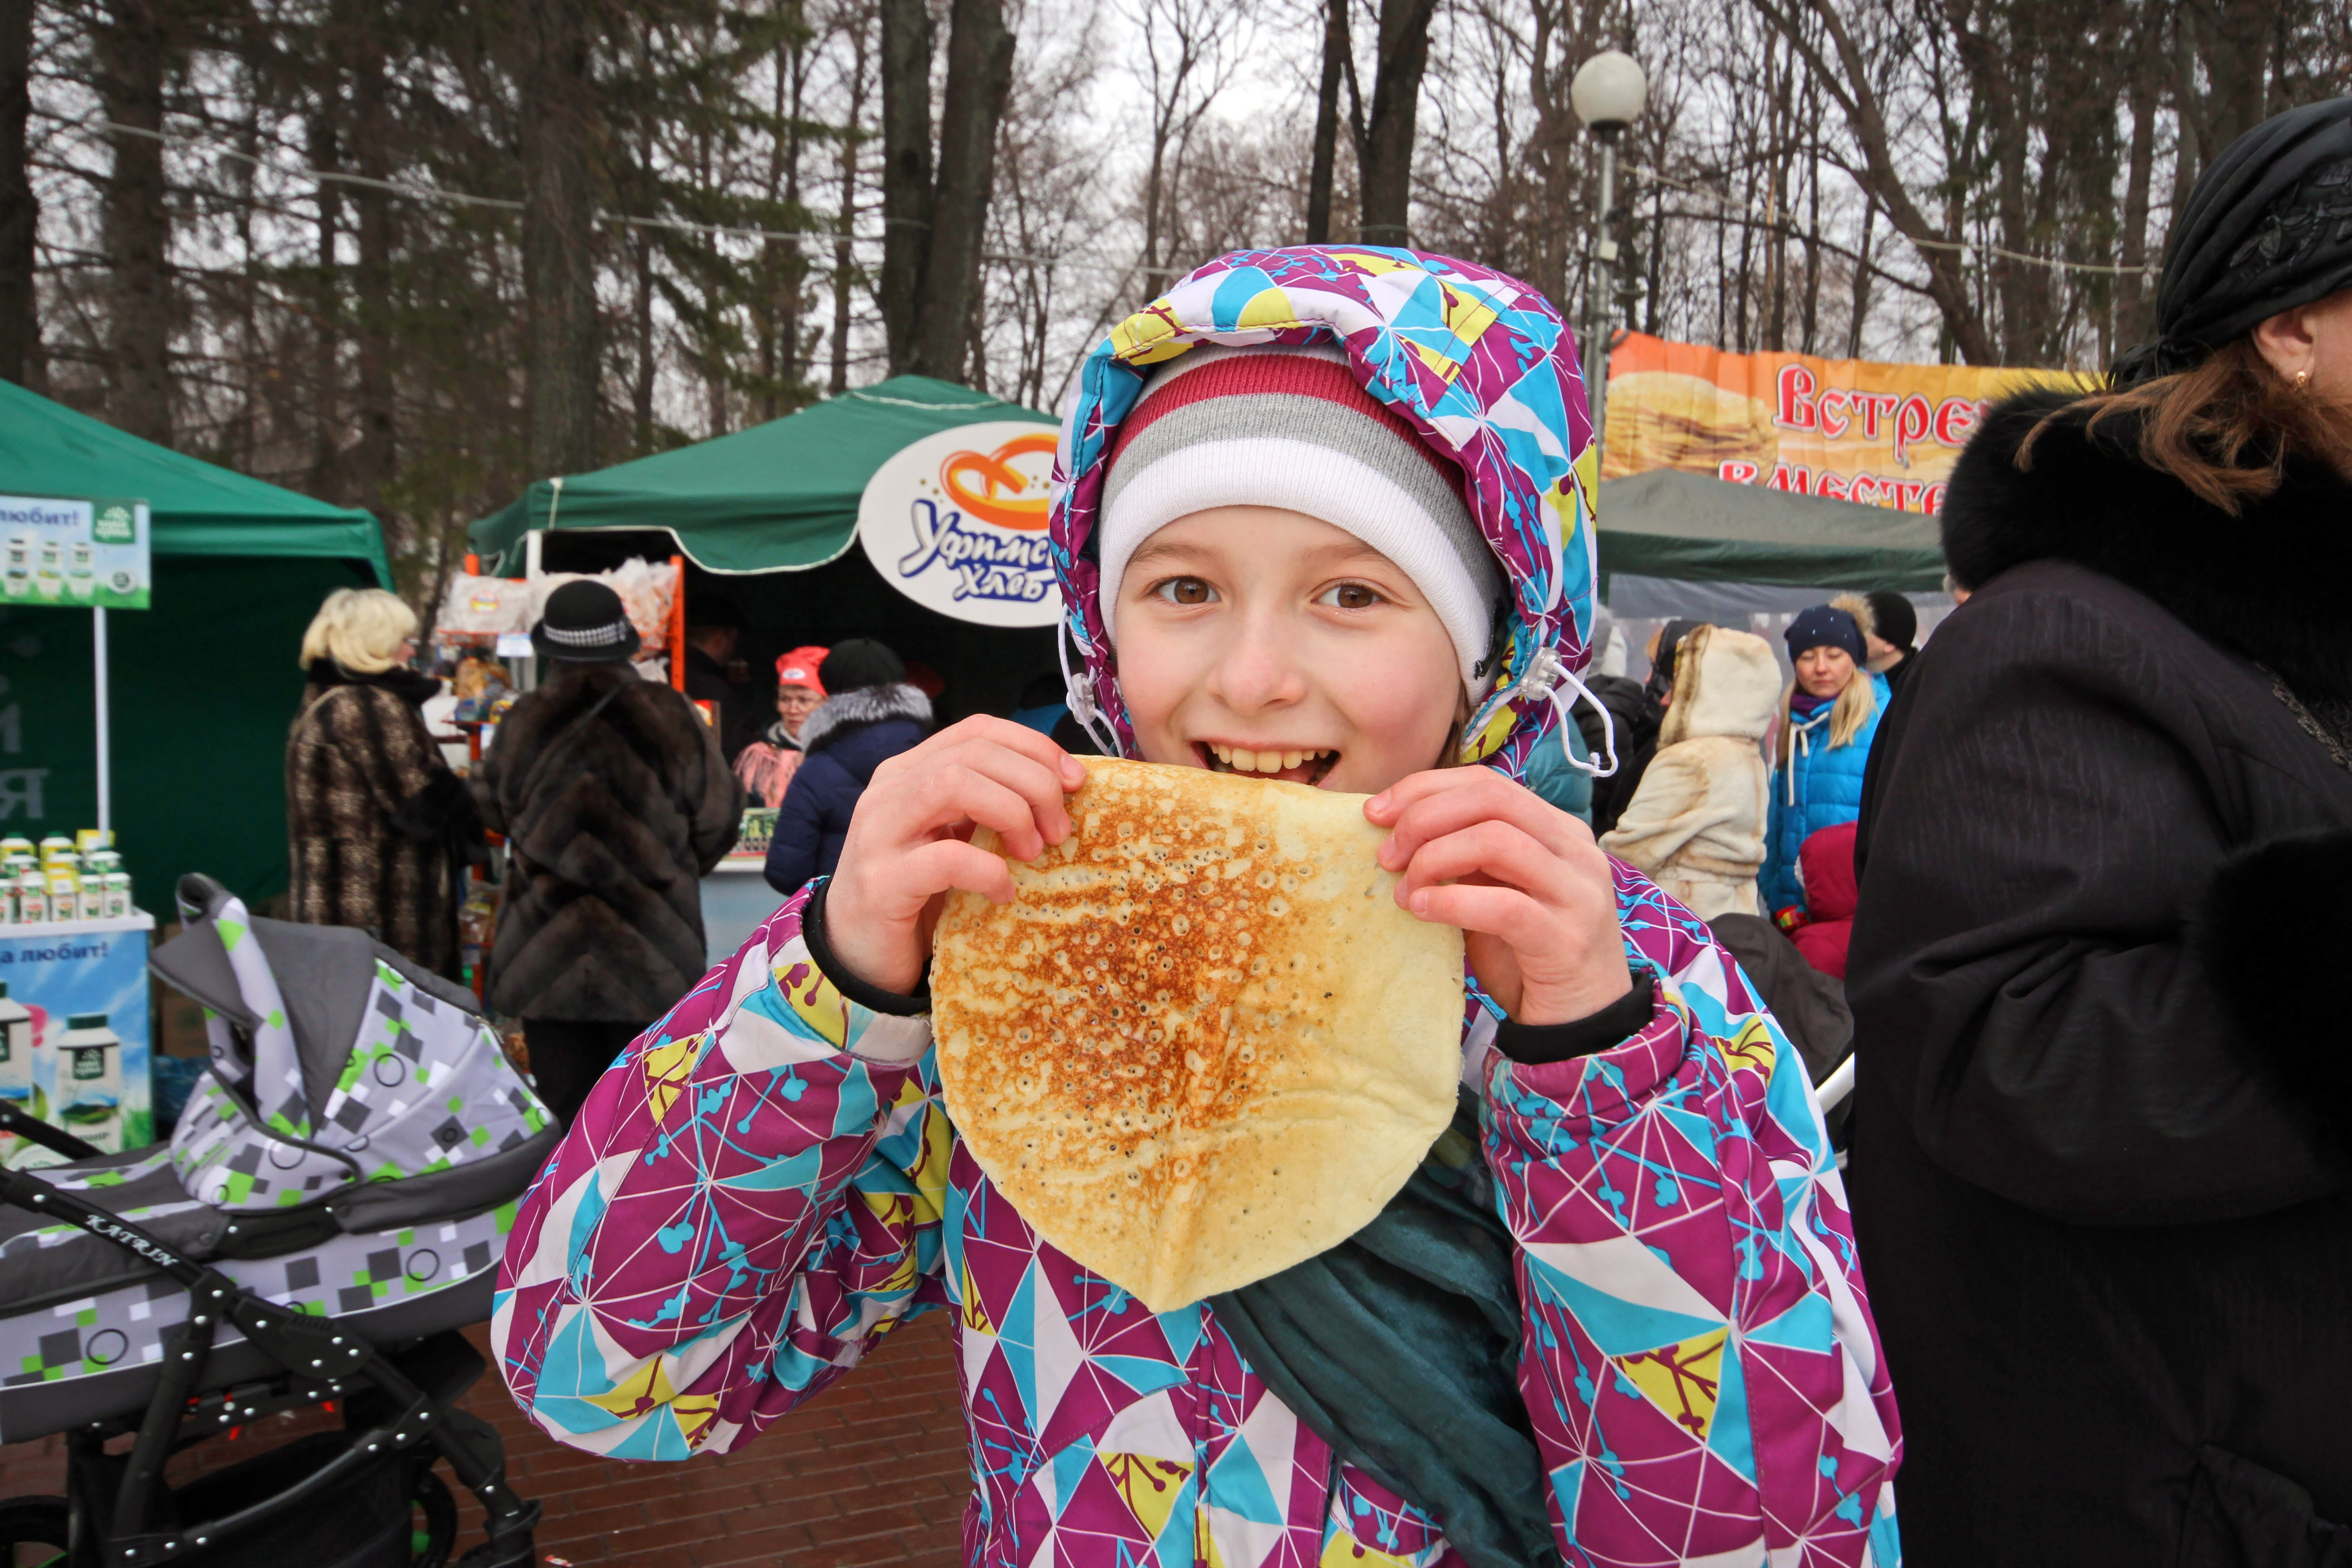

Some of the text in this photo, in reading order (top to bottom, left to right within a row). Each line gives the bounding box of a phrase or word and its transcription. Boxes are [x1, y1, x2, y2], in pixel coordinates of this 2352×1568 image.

[1772, 363, 1993, 468] Встре
[898, 499, 1054, 578] Уфимс
[953, 564, 1059, 603] Хлеб
[20, 941, 108, 962] любит!
[84, 1214, 180, 1266] KATRIN
